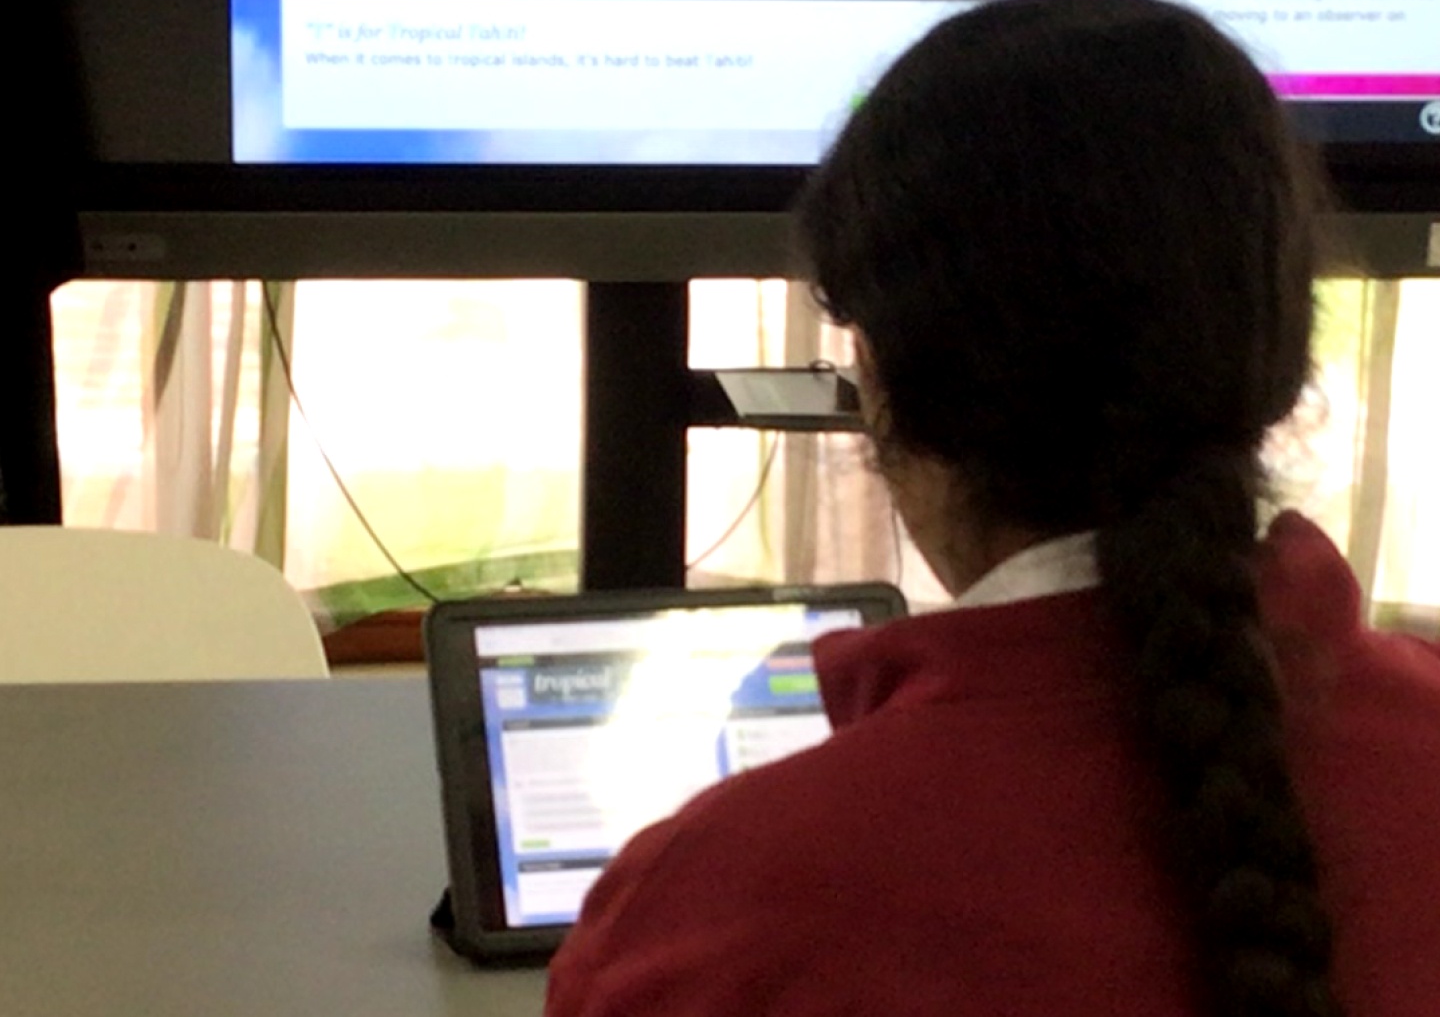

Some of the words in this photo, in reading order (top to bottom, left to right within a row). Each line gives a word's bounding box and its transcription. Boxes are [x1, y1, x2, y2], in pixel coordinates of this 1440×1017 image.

[337, 26, 352, 40] is
[353, 23, 384, 43] for
[388, 24, 463, 44] Tropical
[468, 25, 526, 41] Tahiti!
[304, 52, 350, 65] When
[355, 52, 365, 64] it
[370, 55, 422, 66] comes
[426, 54, 443, 66] to
[448, 55, 506, 68] tropical
[512, 55, 568, 67] islands,
[577, 55, 599, 67] it's
[604, 55, 640, 67] hard
[644, 55, 660, 67] to
[665, 55, 700, 67] beat
[707, 55, 753, 68] Tahiti!
